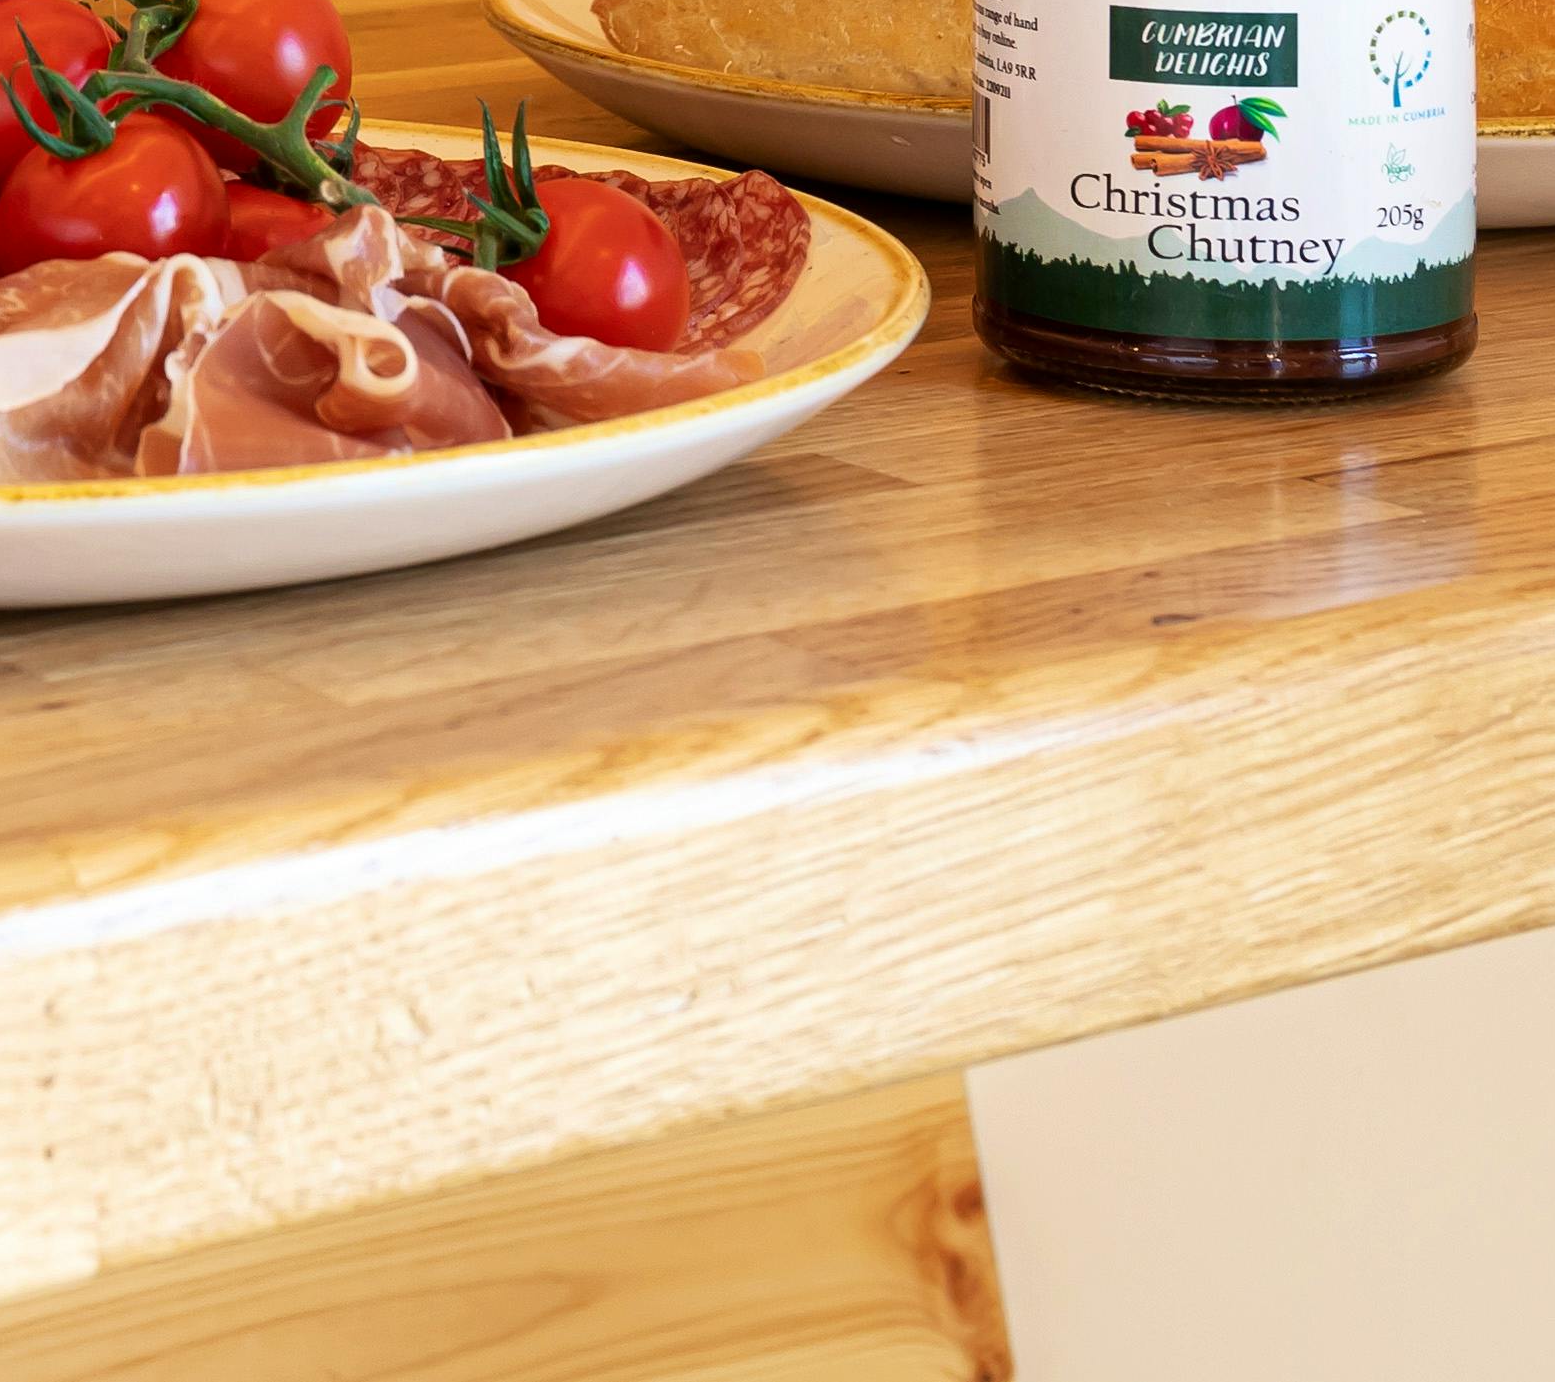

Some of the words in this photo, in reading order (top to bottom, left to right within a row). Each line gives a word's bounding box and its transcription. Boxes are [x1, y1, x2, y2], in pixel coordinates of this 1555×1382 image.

[1014, 13, 1039, 32] hand
[1141, 21, 1286, 49] CUMBRIAN
[996, 58, 1013, 75] LA9
[1015, 64, 1038, 81] 5RR
[1155, 51, 1270, 78] DELIGHTS
[1348, 116, 1382, 126] MADE
[1387, 114, 1399, 124] IN
[1403, 106, 1446, 123] CUMBRIA
[1070, 173, 1301, 222] Christmas
[1376, 203, 1425, 231] 205g
[1147, 223, 1346, 276] Chutney
